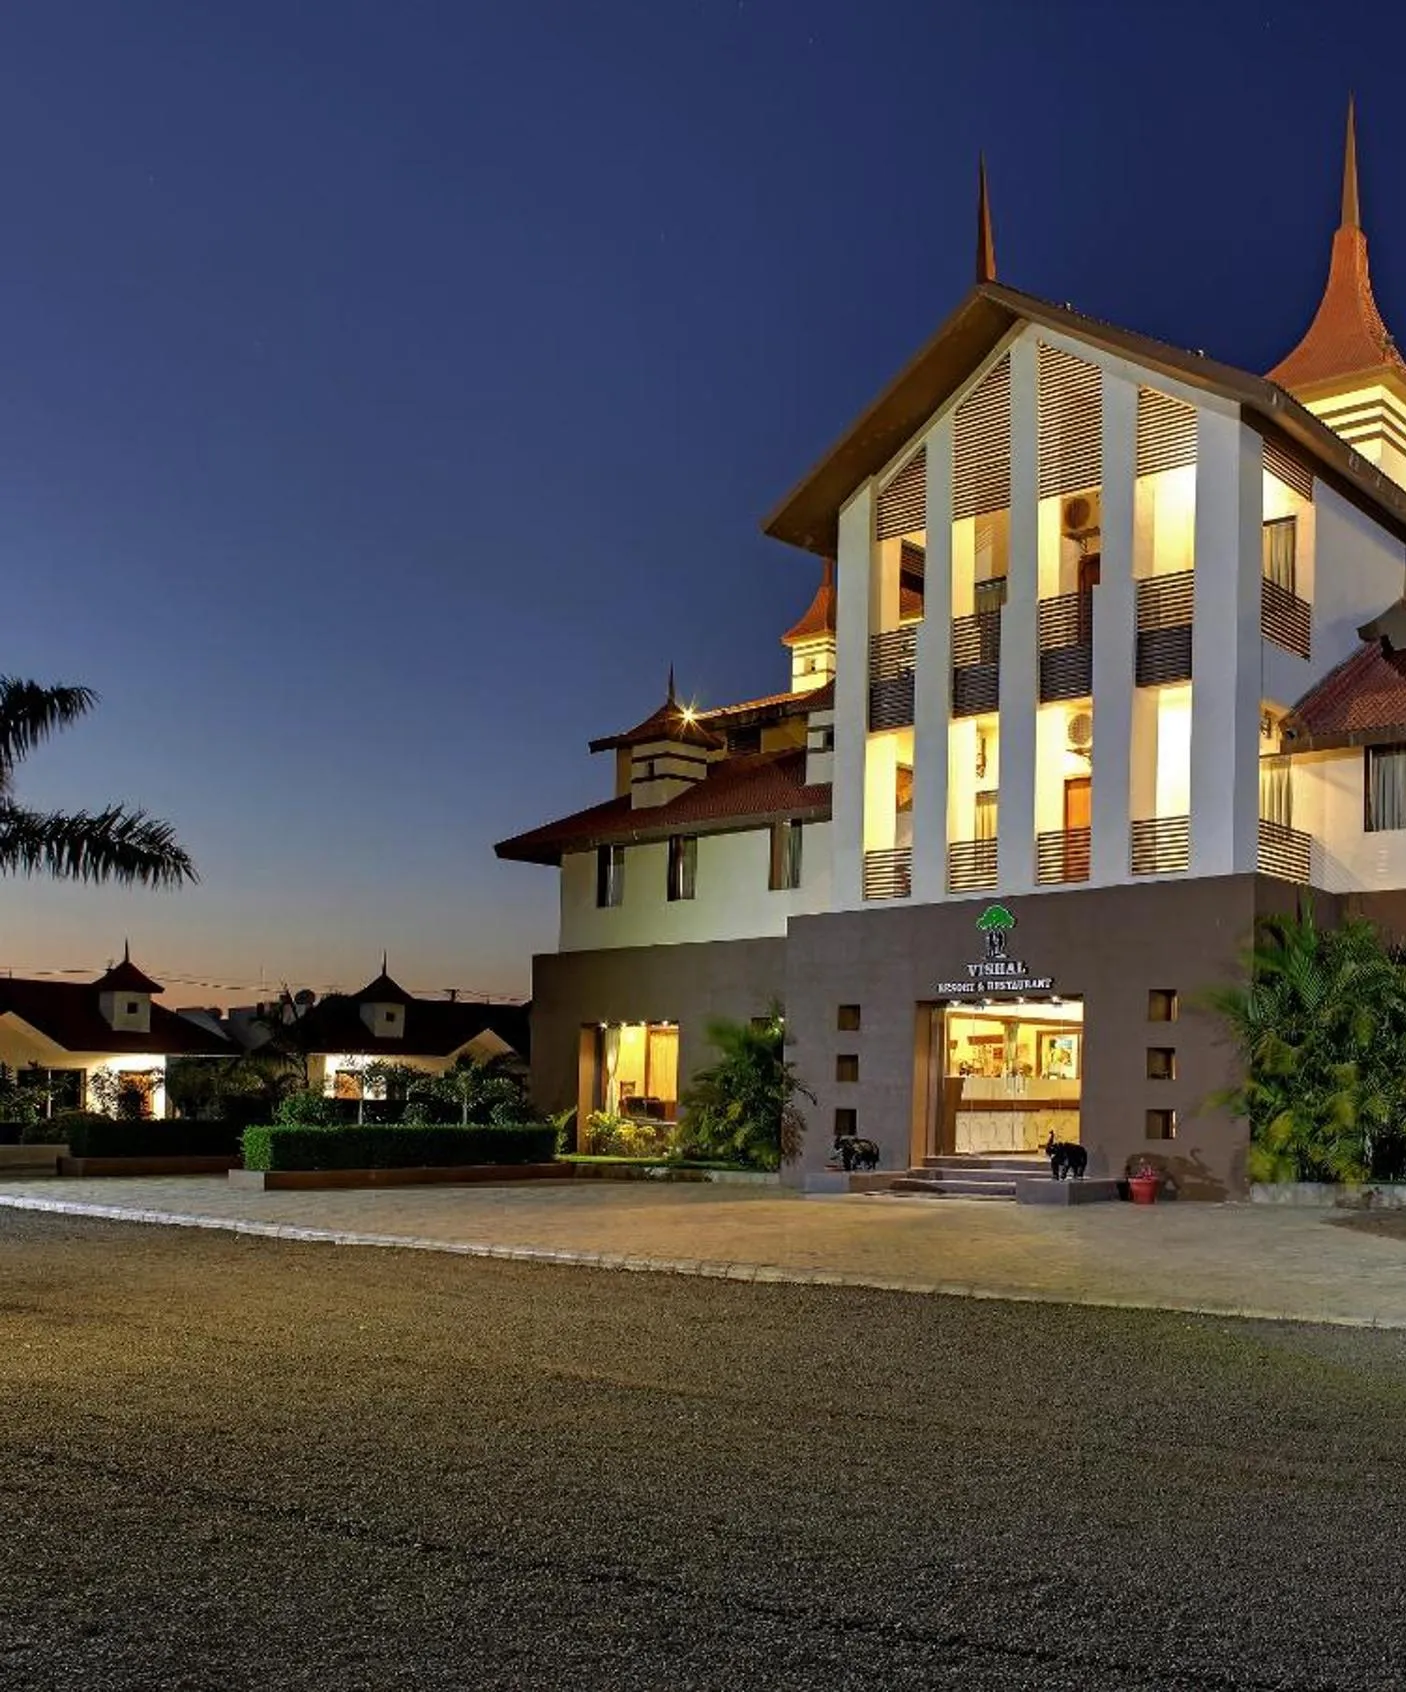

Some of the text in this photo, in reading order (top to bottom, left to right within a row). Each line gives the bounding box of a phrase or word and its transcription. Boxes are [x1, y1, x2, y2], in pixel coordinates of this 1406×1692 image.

[967, 961, 1026, 977] VISHAL
[938, 978, 1053, 993] RESORT & RESTAURANT
